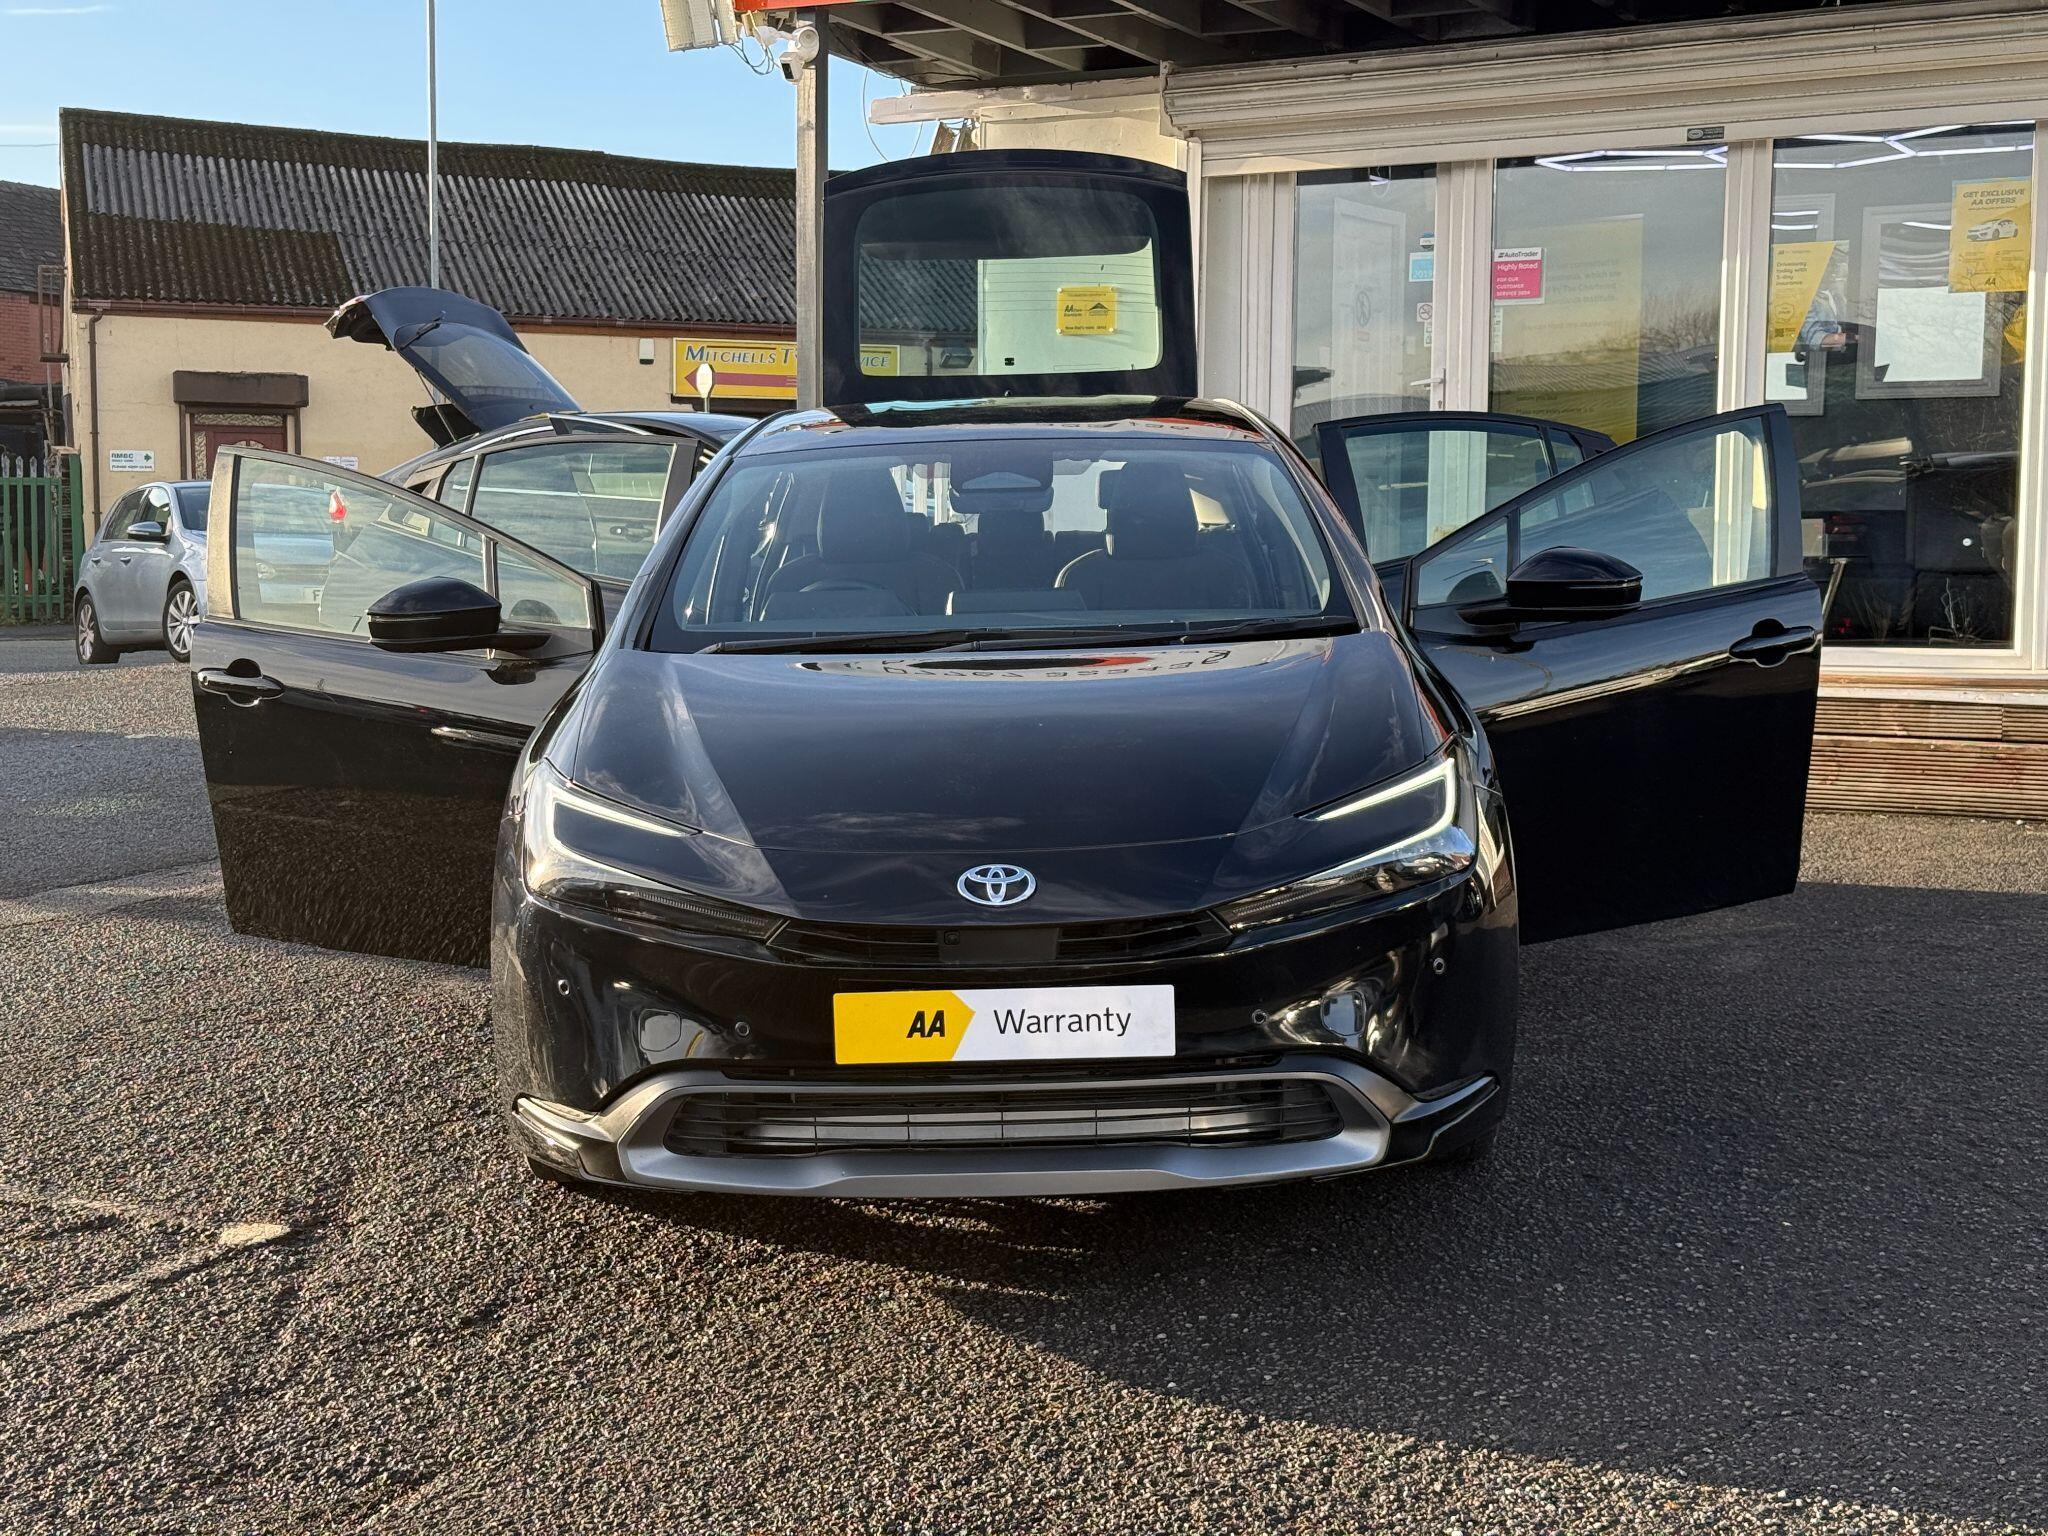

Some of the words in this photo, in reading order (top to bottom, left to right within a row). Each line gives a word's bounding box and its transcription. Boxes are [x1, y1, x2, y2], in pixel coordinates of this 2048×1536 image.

[1980, 188, 2025, 197] EXCLUSIVE
[1985, 197, 2016, 205] OFFERS
[1497, 263, 1518, 272] Highly
[1984, 277, 1997, 286] AA
[906, 1009, 946, 1039] AA
[994, 1007, 1132, 1037] Warranty
